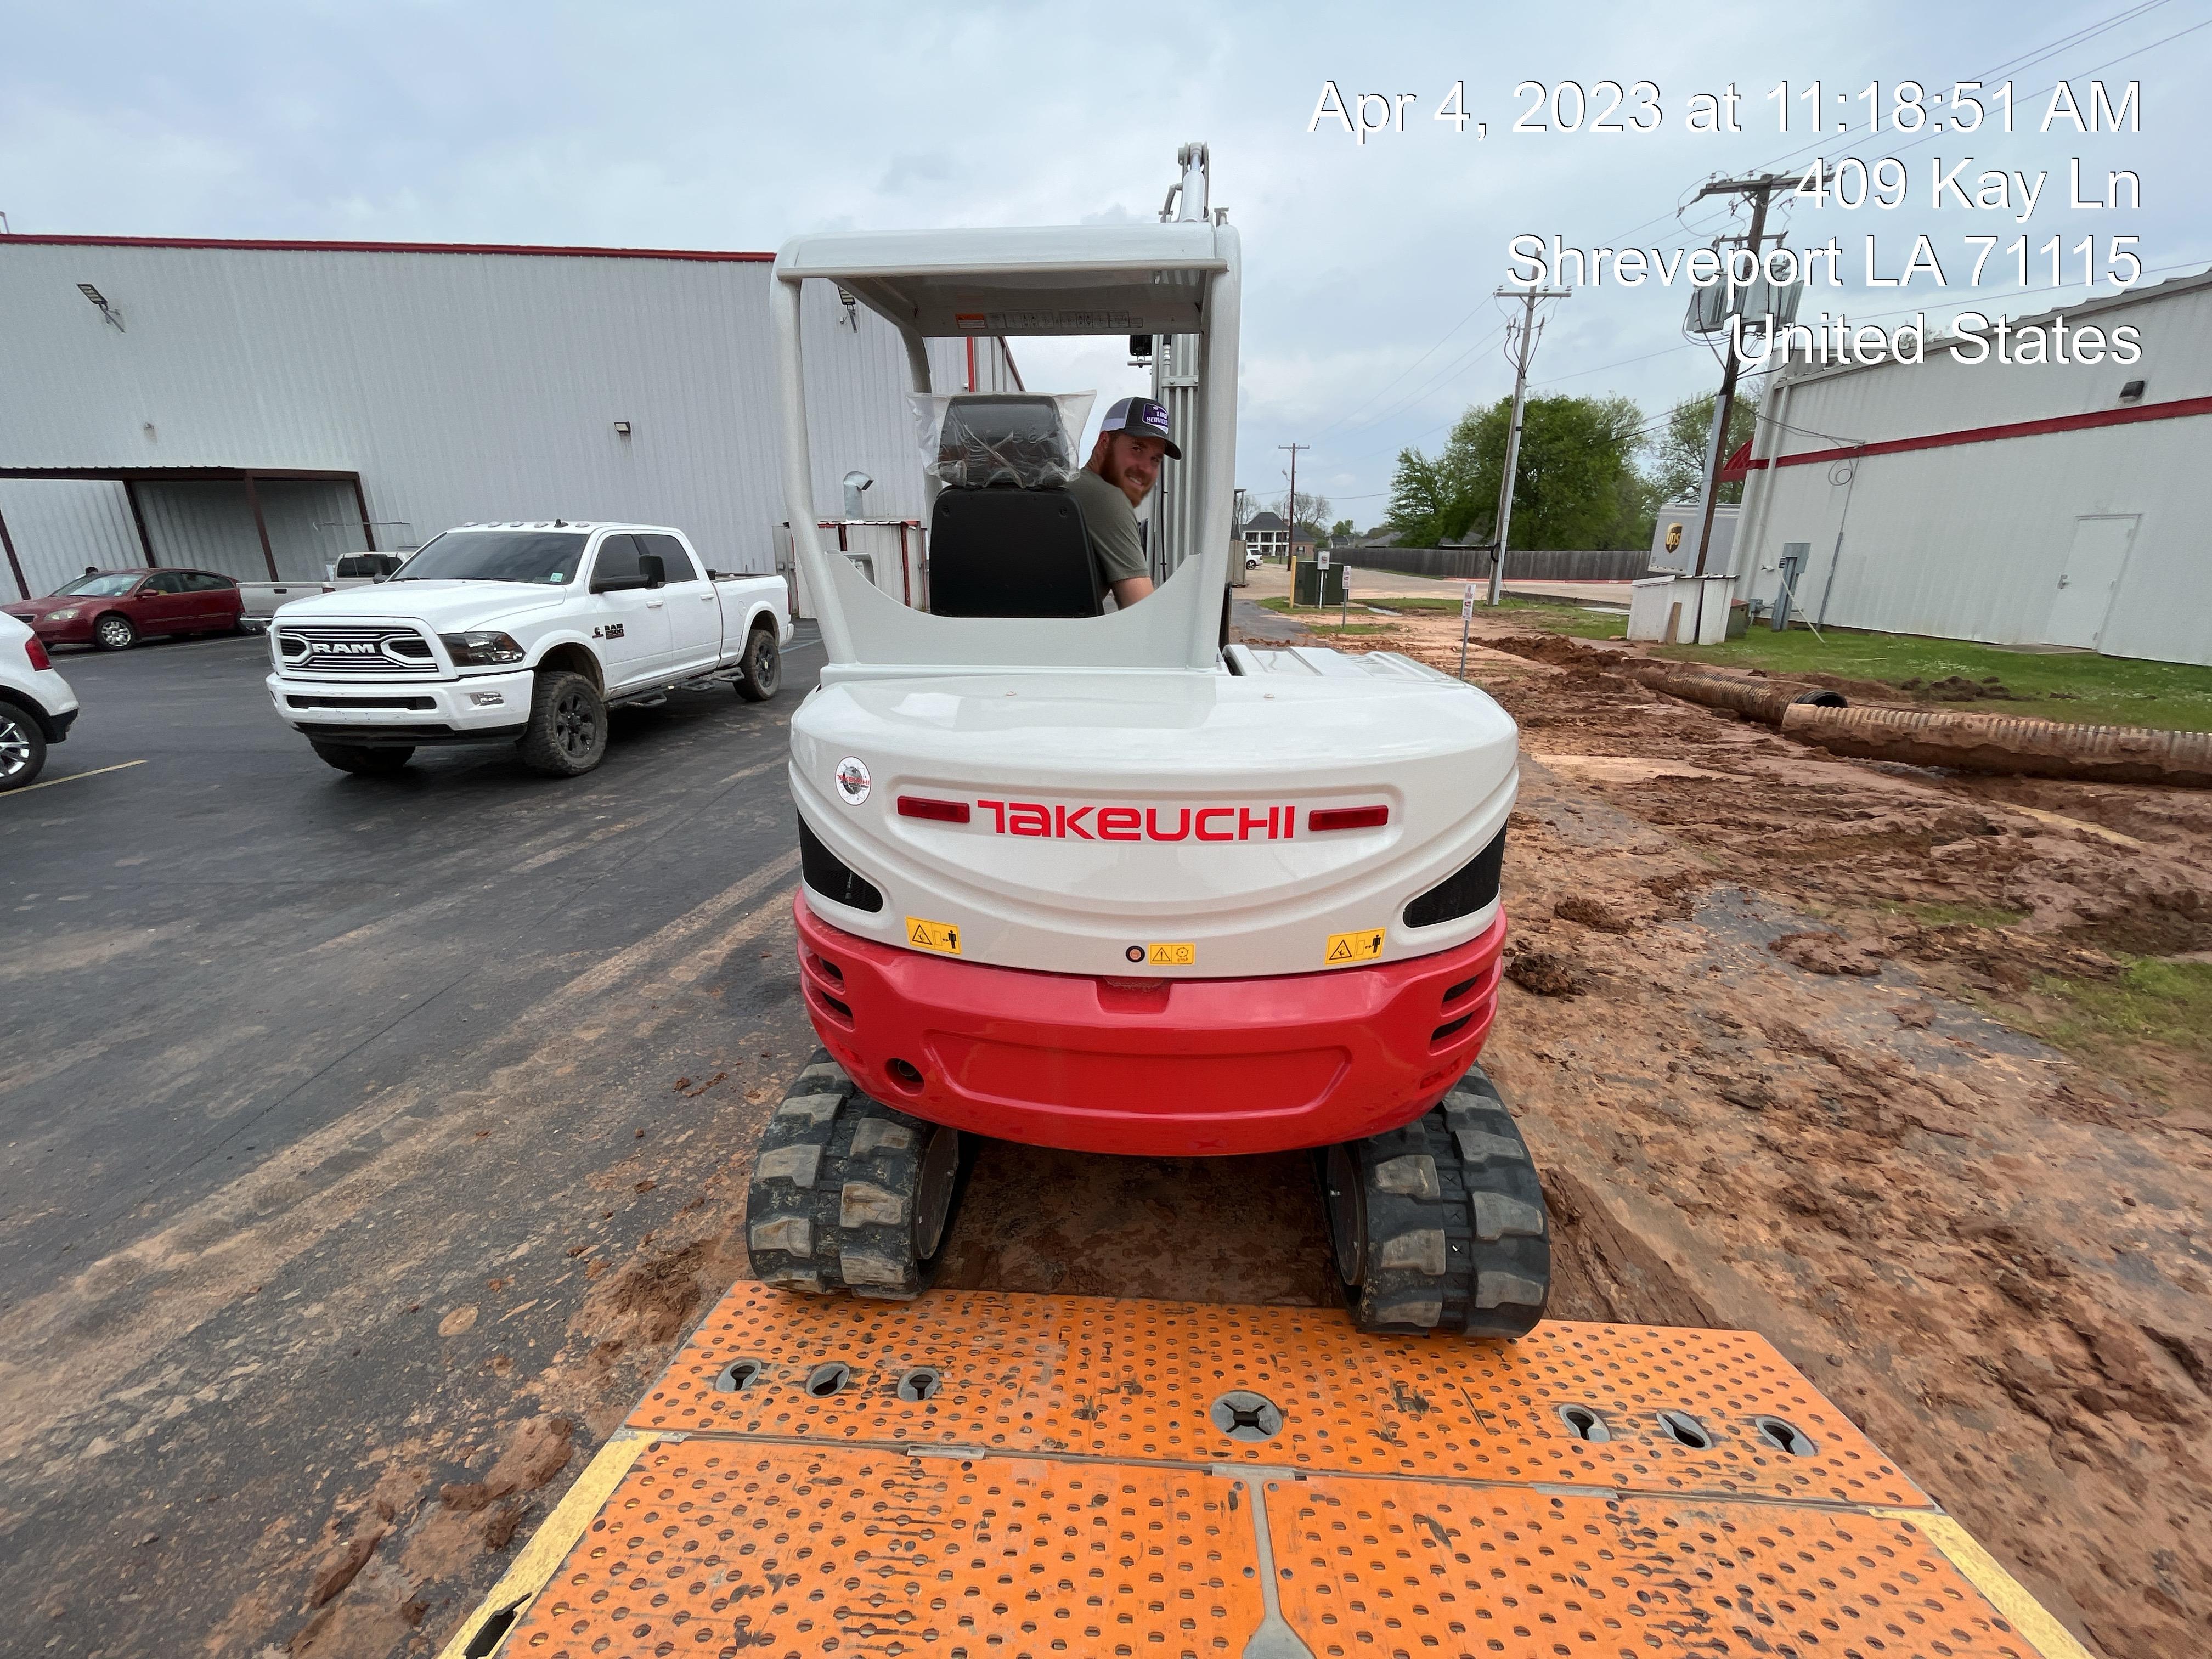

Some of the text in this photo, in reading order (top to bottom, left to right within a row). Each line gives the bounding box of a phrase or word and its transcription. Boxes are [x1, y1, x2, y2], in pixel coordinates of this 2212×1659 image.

[1666, 533, 1680, 550] ups
[311, 643, 376, 653] RAM
[977, 799, 1295, 841] TAKEUCHI
